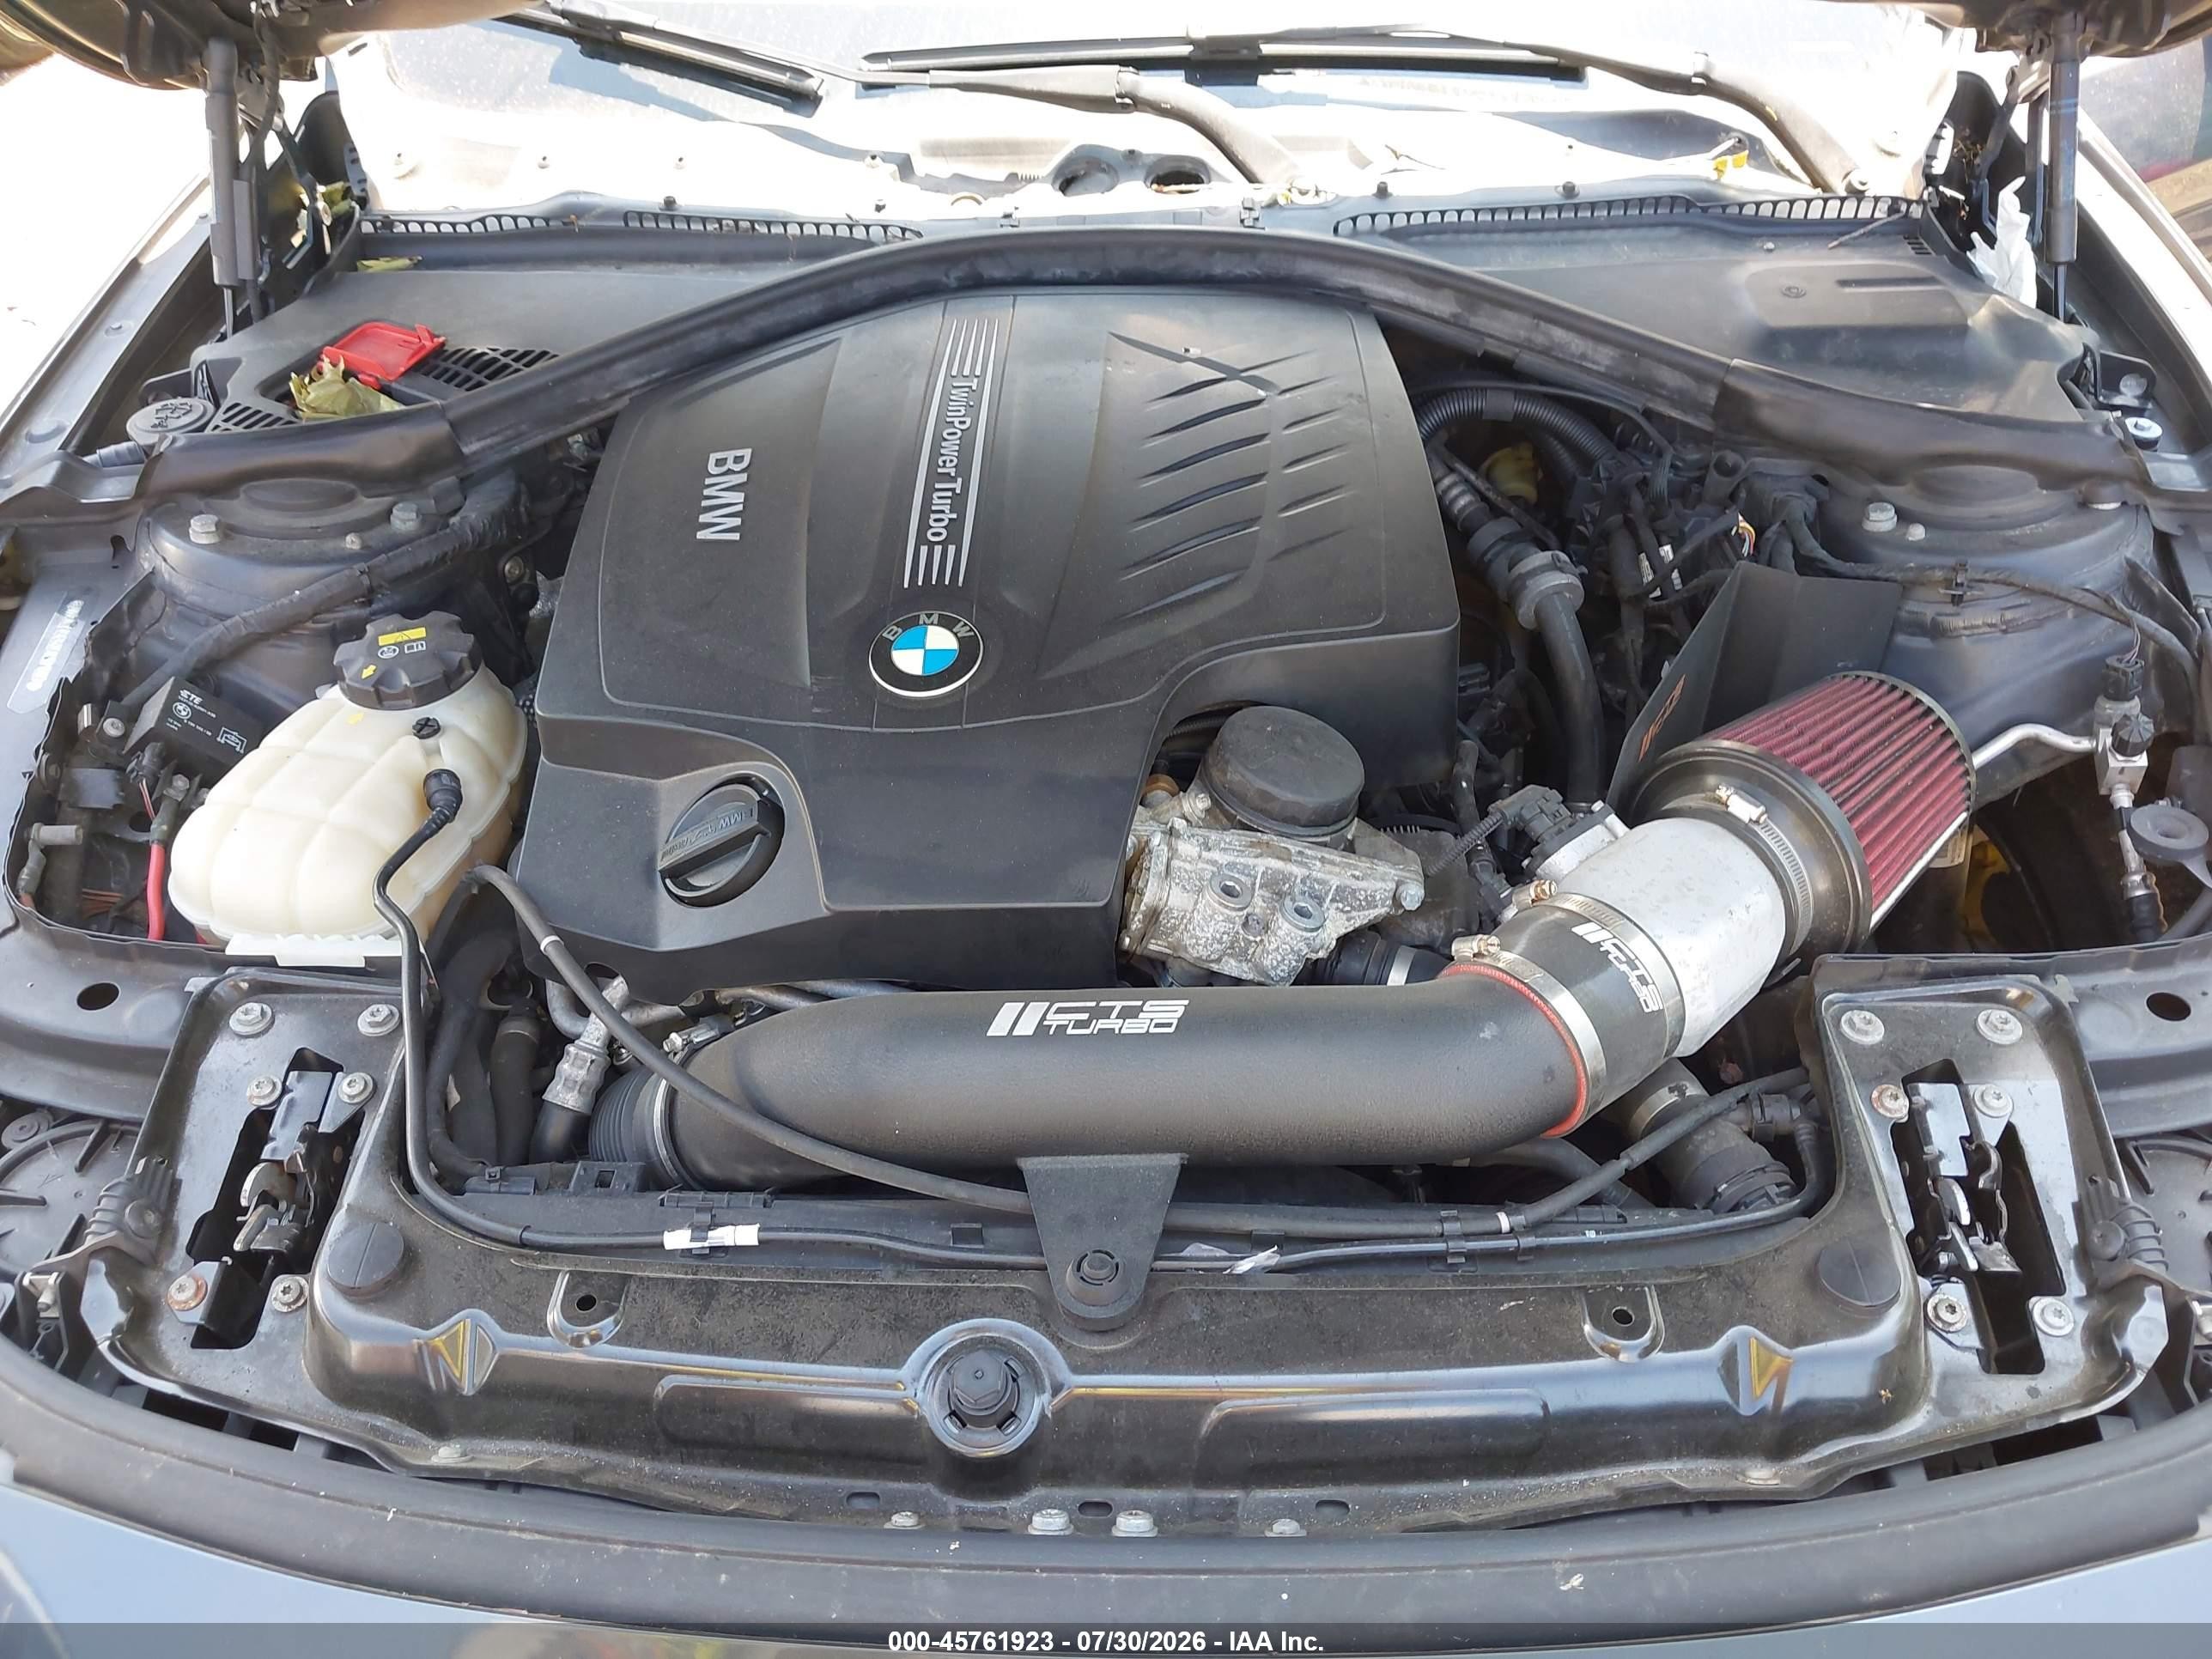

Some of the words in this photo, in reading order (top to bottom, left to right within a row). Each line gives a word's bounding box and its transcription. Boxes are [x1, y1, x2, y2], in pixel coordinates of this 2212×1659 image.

[937, 378, 978, 477] TwinPower
[696, 447, 752, 540] BMW
[927, 477, 963, 542] Turbo
[882, 612, 975, 641] BMW
[1601, 937, 1664, 1011] CTS
[1042, 1018, 1179, 1036] TURBO
[1045, 1000, 1190, 1021] CTS
